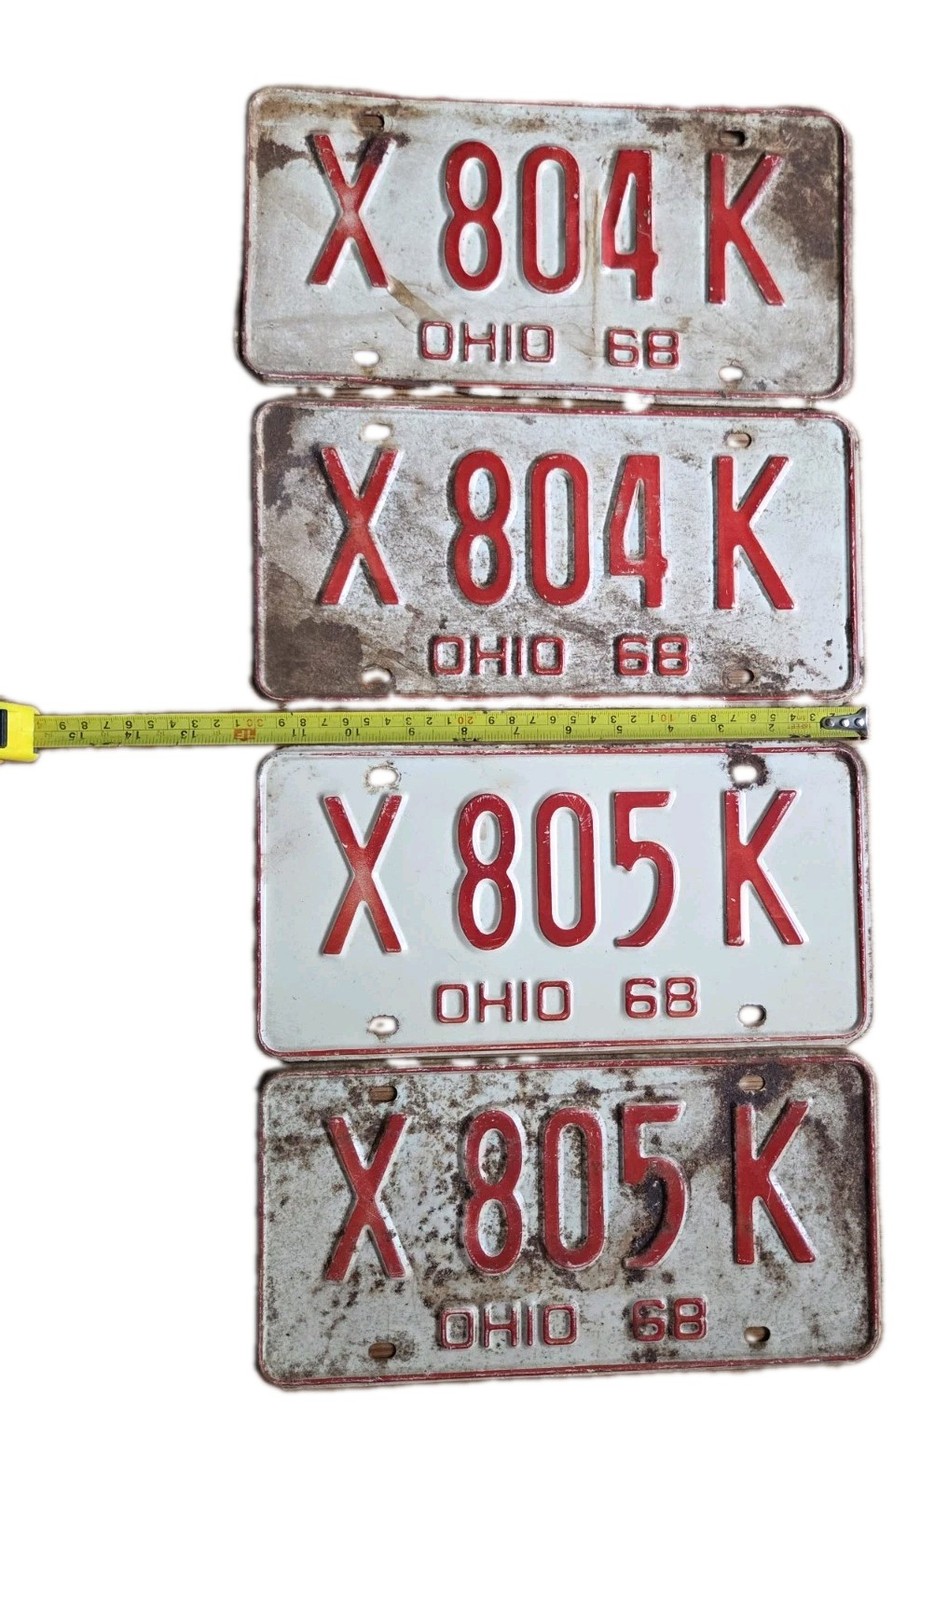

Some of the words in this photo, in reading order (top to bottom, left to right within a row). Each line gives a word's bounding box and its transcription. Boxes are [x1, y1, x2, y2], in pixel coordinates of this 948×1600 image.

[310, 133, 392, 287] X
[443, 140, 659, 300] 804
[706, 151, 784, 305] K
[420, 323, 555, 362] OHIO
[607, 330, 680, 368] 68
[318, 447, 399, 605] X
[452, 450, 667, 610] 804
[716, 455, 794, 610] K
[430, 635, 564, 676] OHIO
[615, 634, 689, 676] 68
[342, 717, 349, 726] 6
[363, 717, 370, 726] 5
[385, 717, 391, 725] 4
[405, 717, 412, 725] 3
[426, 717, 433, 725] 2
[447, 716, 452, 725] 1
[488, 716, 495, 725] 9
[508, 716, 516, 724] 8
[529, 716, 536, 724] 7
[550, 715, 557, 724] 6
[570, 715, 577, 724] 5
[590, 715, 597, 723] 4
[610, 715, 617, 723] 3
[630, 715, 637, 723] 2
[690, 714, 697, 722] 9
[710, 714, 717, 722] 8
[730, 714, 737, 722] 7
[750, 713, 757, 722] 6
[769, 713, 777, 722] 5
[790, 713, 797, 721] 4
[809, 713, 816, 721] 3
[59, 722, 67, 730] 9
[81, 721, 88, 730] 8
[103, 721, 110, 729] 7
[125, 720, 133, 729] 6
[147, 720, 155, 729] 5
[169, 720, 176, 728] 4
[191, 720, 198, 728] 3
[213, 719, 220, 728] 2
[235, 719, 241, 727] 1
[278, 718, 286, 727] 9
[300, 718, 307, 727] 8
[321, 718, 328, 726] 7
[408, 727, 415, 736] 9
[461, 726, 468, 735] 8
[513, 726, 520, 735] 7
[565, 725, 572, 734] 6
[616, 725, 623, 734] 5
[667, 724, 674, 733] 4
[717, 724, 725, 732] 3
[768, 723, 775, 732] 2
[322, 794, 402, 955] X
[457, 791, 675, 950] 805
[724, 790, 803, 946] K
[435, 980, 571, 1024] OHIO
[625, 977, 698, 1019] 68
[325, 1113, 407, 1281] X
[464, 1103, 688, 1275] 805
[734, 1100, 815, 1265] K
[439, 1302, 578, 1350] OHIO
[632, 1297, 707, 1343] 68
